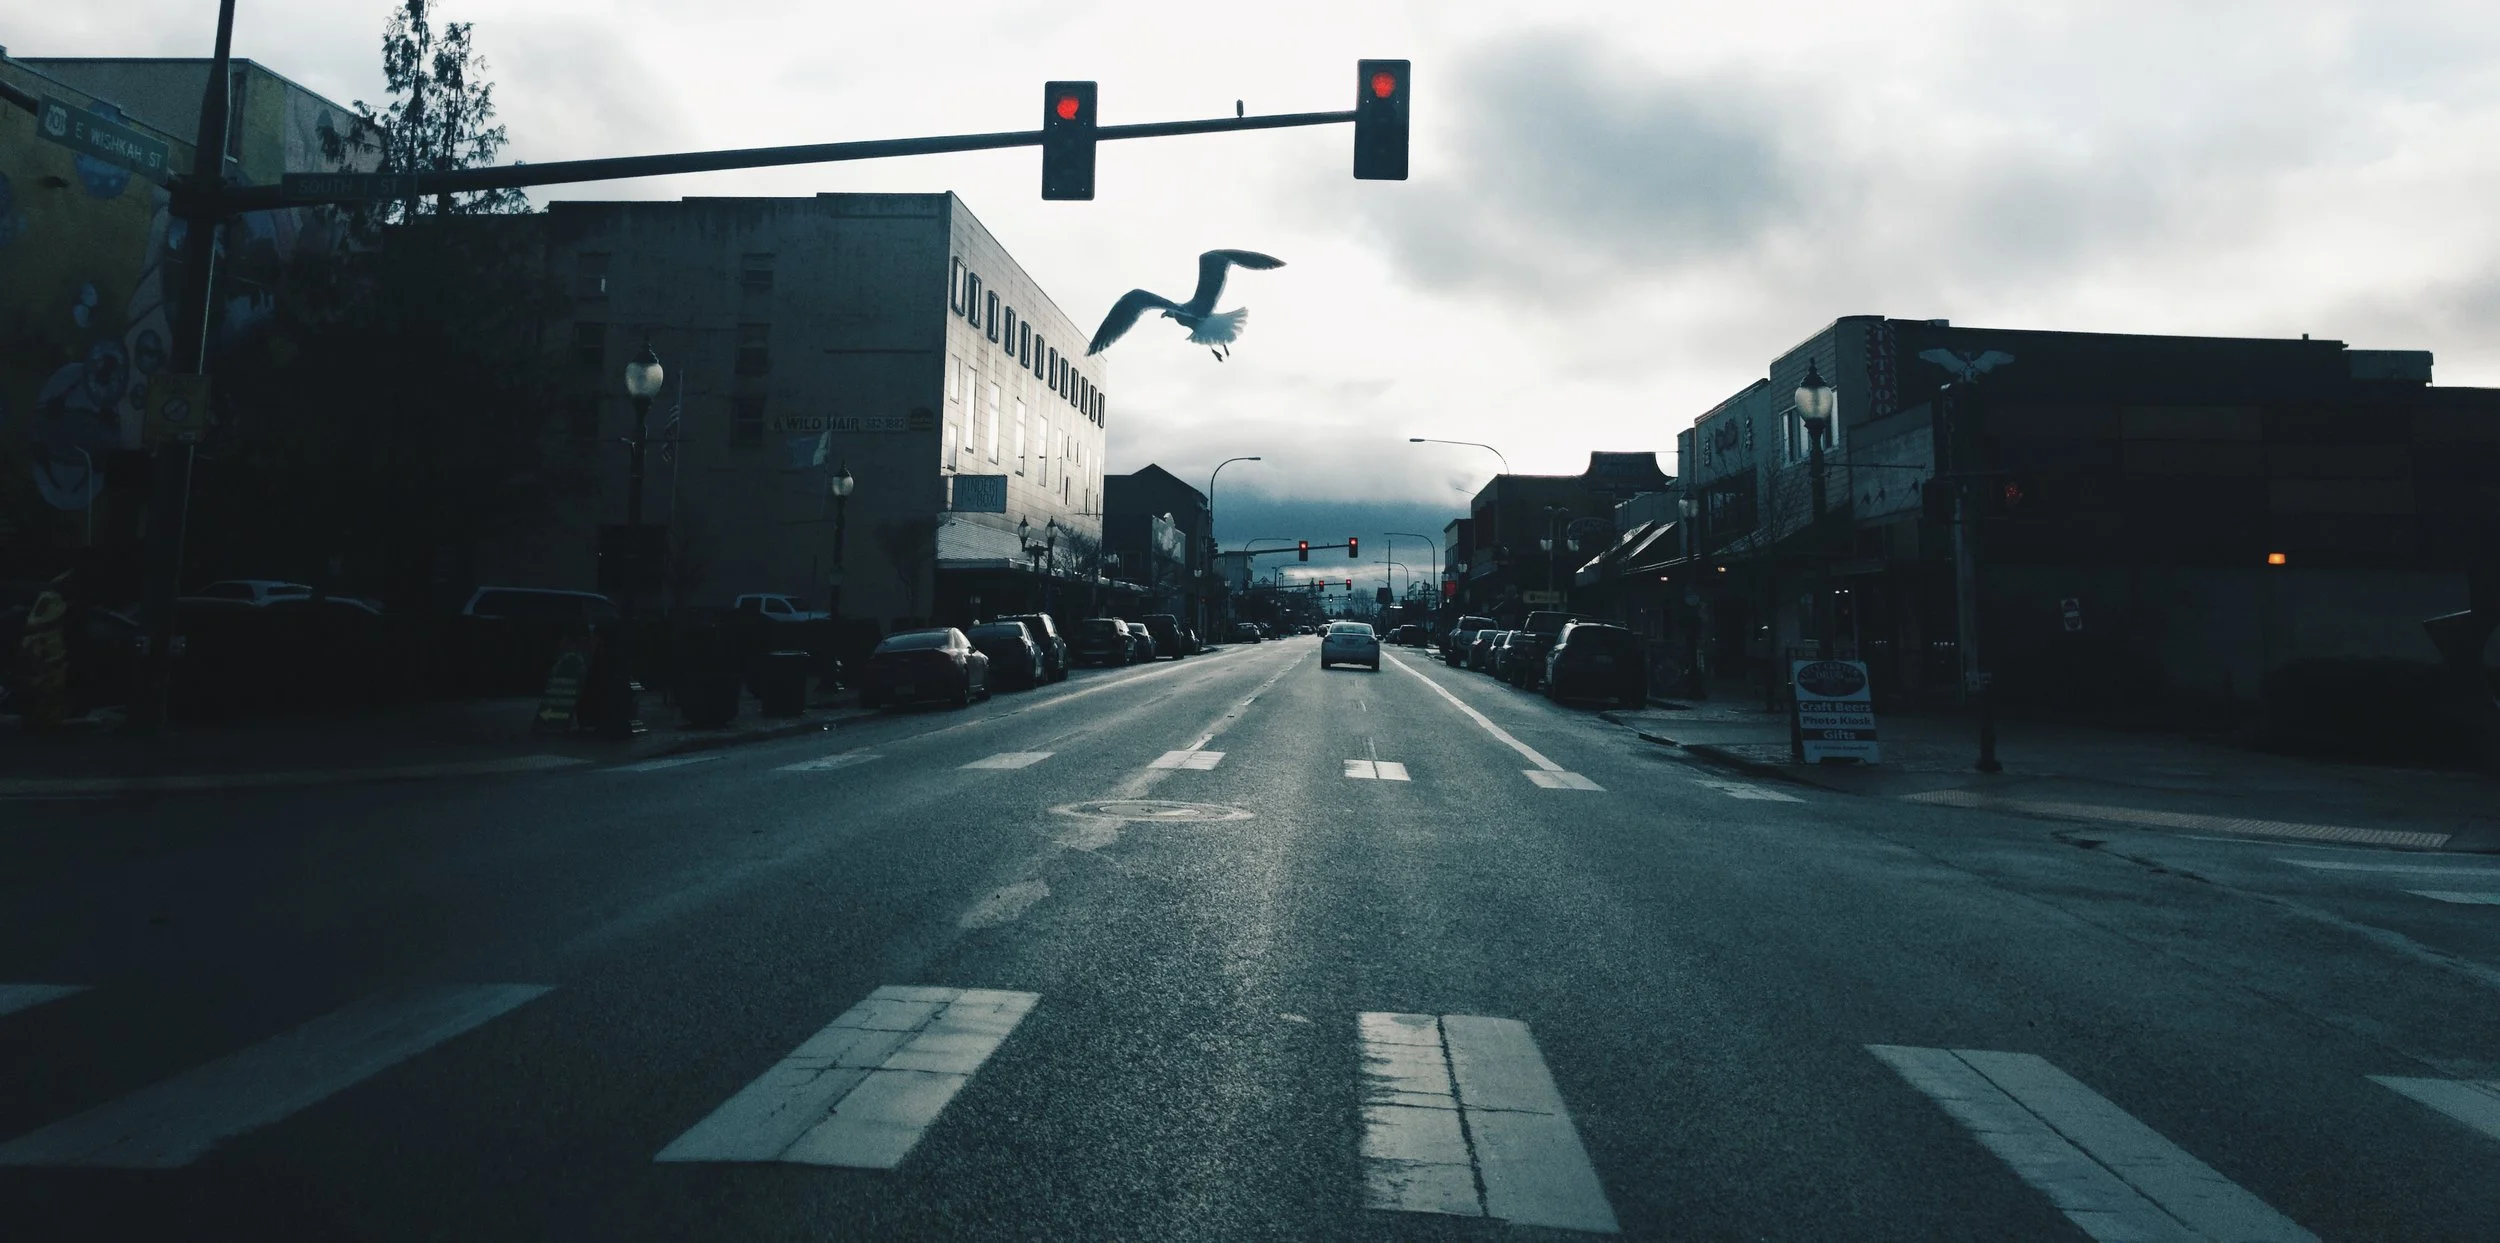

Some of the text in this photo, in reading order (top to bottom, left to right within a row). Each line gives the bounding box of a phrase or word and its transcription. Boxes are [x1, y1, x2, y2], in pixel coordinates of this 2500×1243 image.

[76, 121, 84, 139] E
[91, 127, 143, 161] WISHKAH
[148, 151, 162, 168] ST
[299, 178, 353, 194] SOUTH
[379, 178, 400, 194] ST
[1874, 330, 1891, 415] TATTOO
[787, 412, 822, 431] WILD
[827, 412, 860, 432] HAIR
[1800, 702, 1871, 712] Craft Beers
[1802, 716, 1873, 725] Photo Kiosk
[1823, 730, 1856, 740] Gifts
